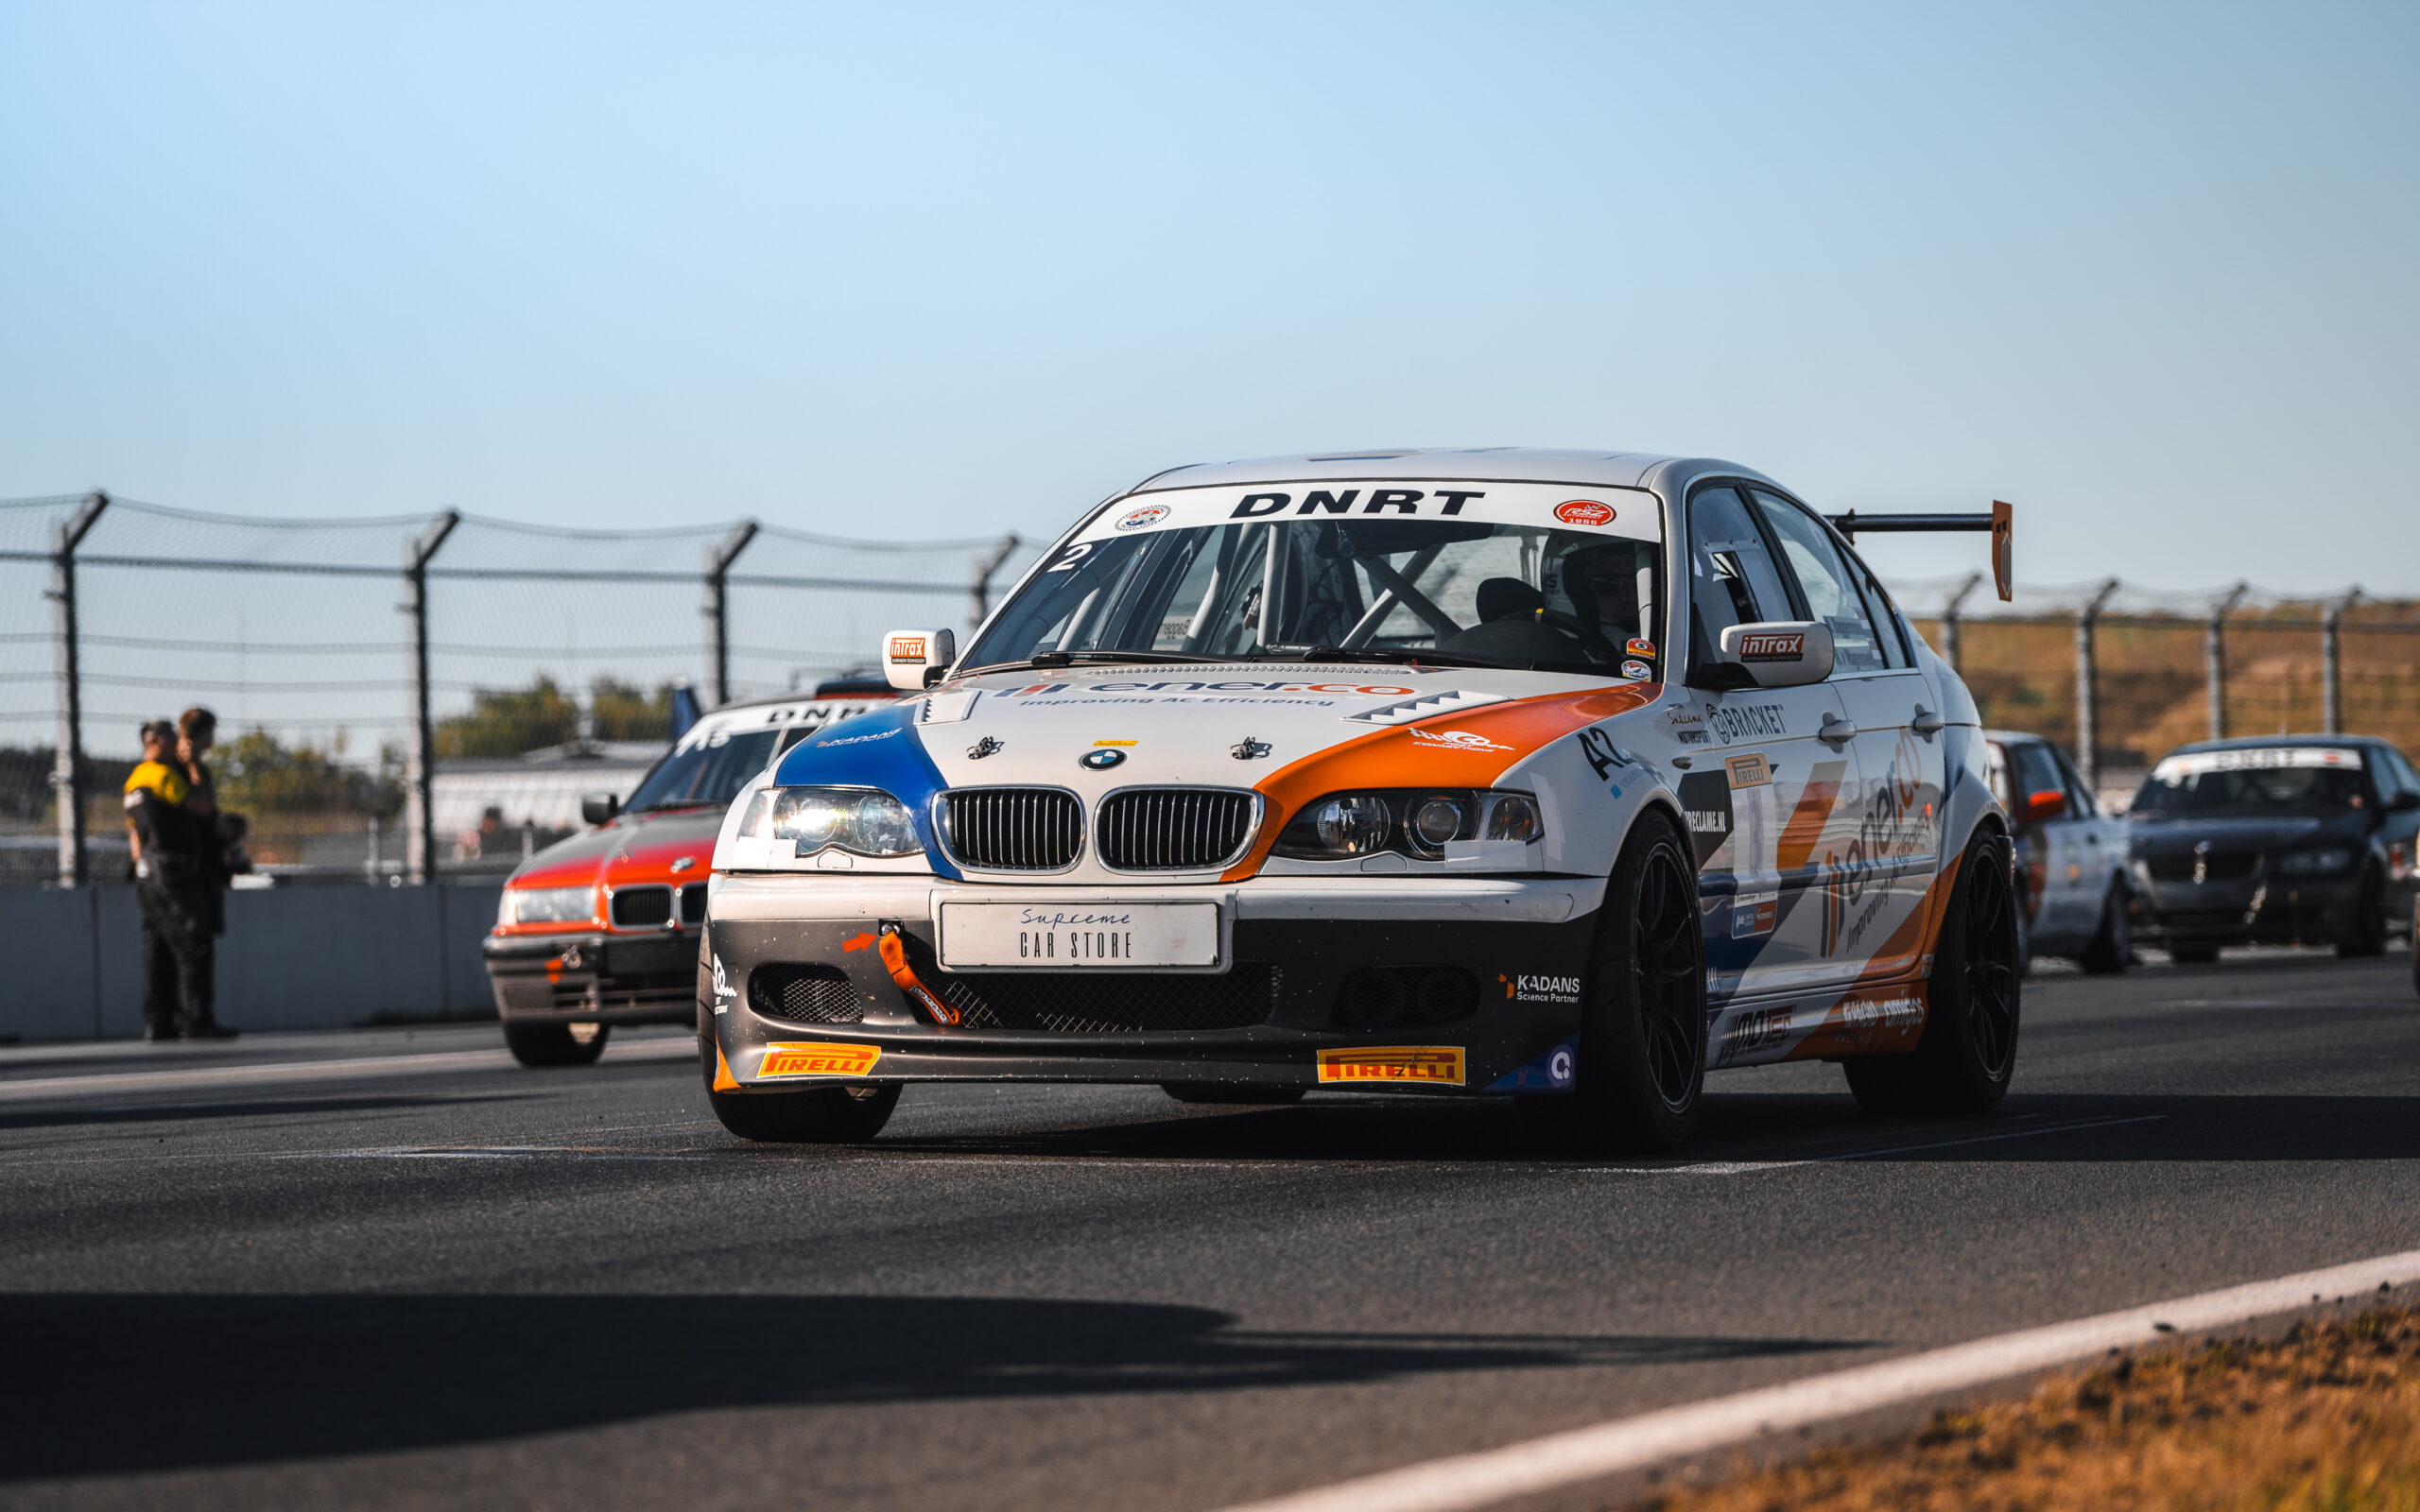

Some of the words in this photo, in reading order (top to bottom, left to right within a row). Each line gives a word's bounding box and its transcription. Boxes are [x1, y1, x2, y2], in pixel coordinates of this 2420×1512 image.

[1229, 489, 1487, 519] DNRT
[1046, 543, 1093, 573] 2
[890, 639, 925, 656] inTrax
[1741, 635, 1802, 654] inTrax
[1089, 681, 1415, 696] ener.co
[1020, 697, 1155, 706] Improving
[1202, 697, 1335, 707] Efficiency
[1721, 705, 1787, 737] BRACKET
[1577, 727, 1636, 782] A2
[1731, 758, 1765, 784] PIRELLI
[1684, 811, 1726, 833] RECLAME.NL
[1020, 908, 1131, 930] Supreme
[1020, 932, 1054, 958] CAR
[1071, 932, 1132, 958] STORE
[1516, 974, 1581, 993] KADANS
[1516, 991, 1548, 1002] Science
[1550, 993, 1579, 1003] Partner
[764, 1051, 873, 1073] PIRELLI
[1325, 1052, 1457, 1079] PIRELLI
